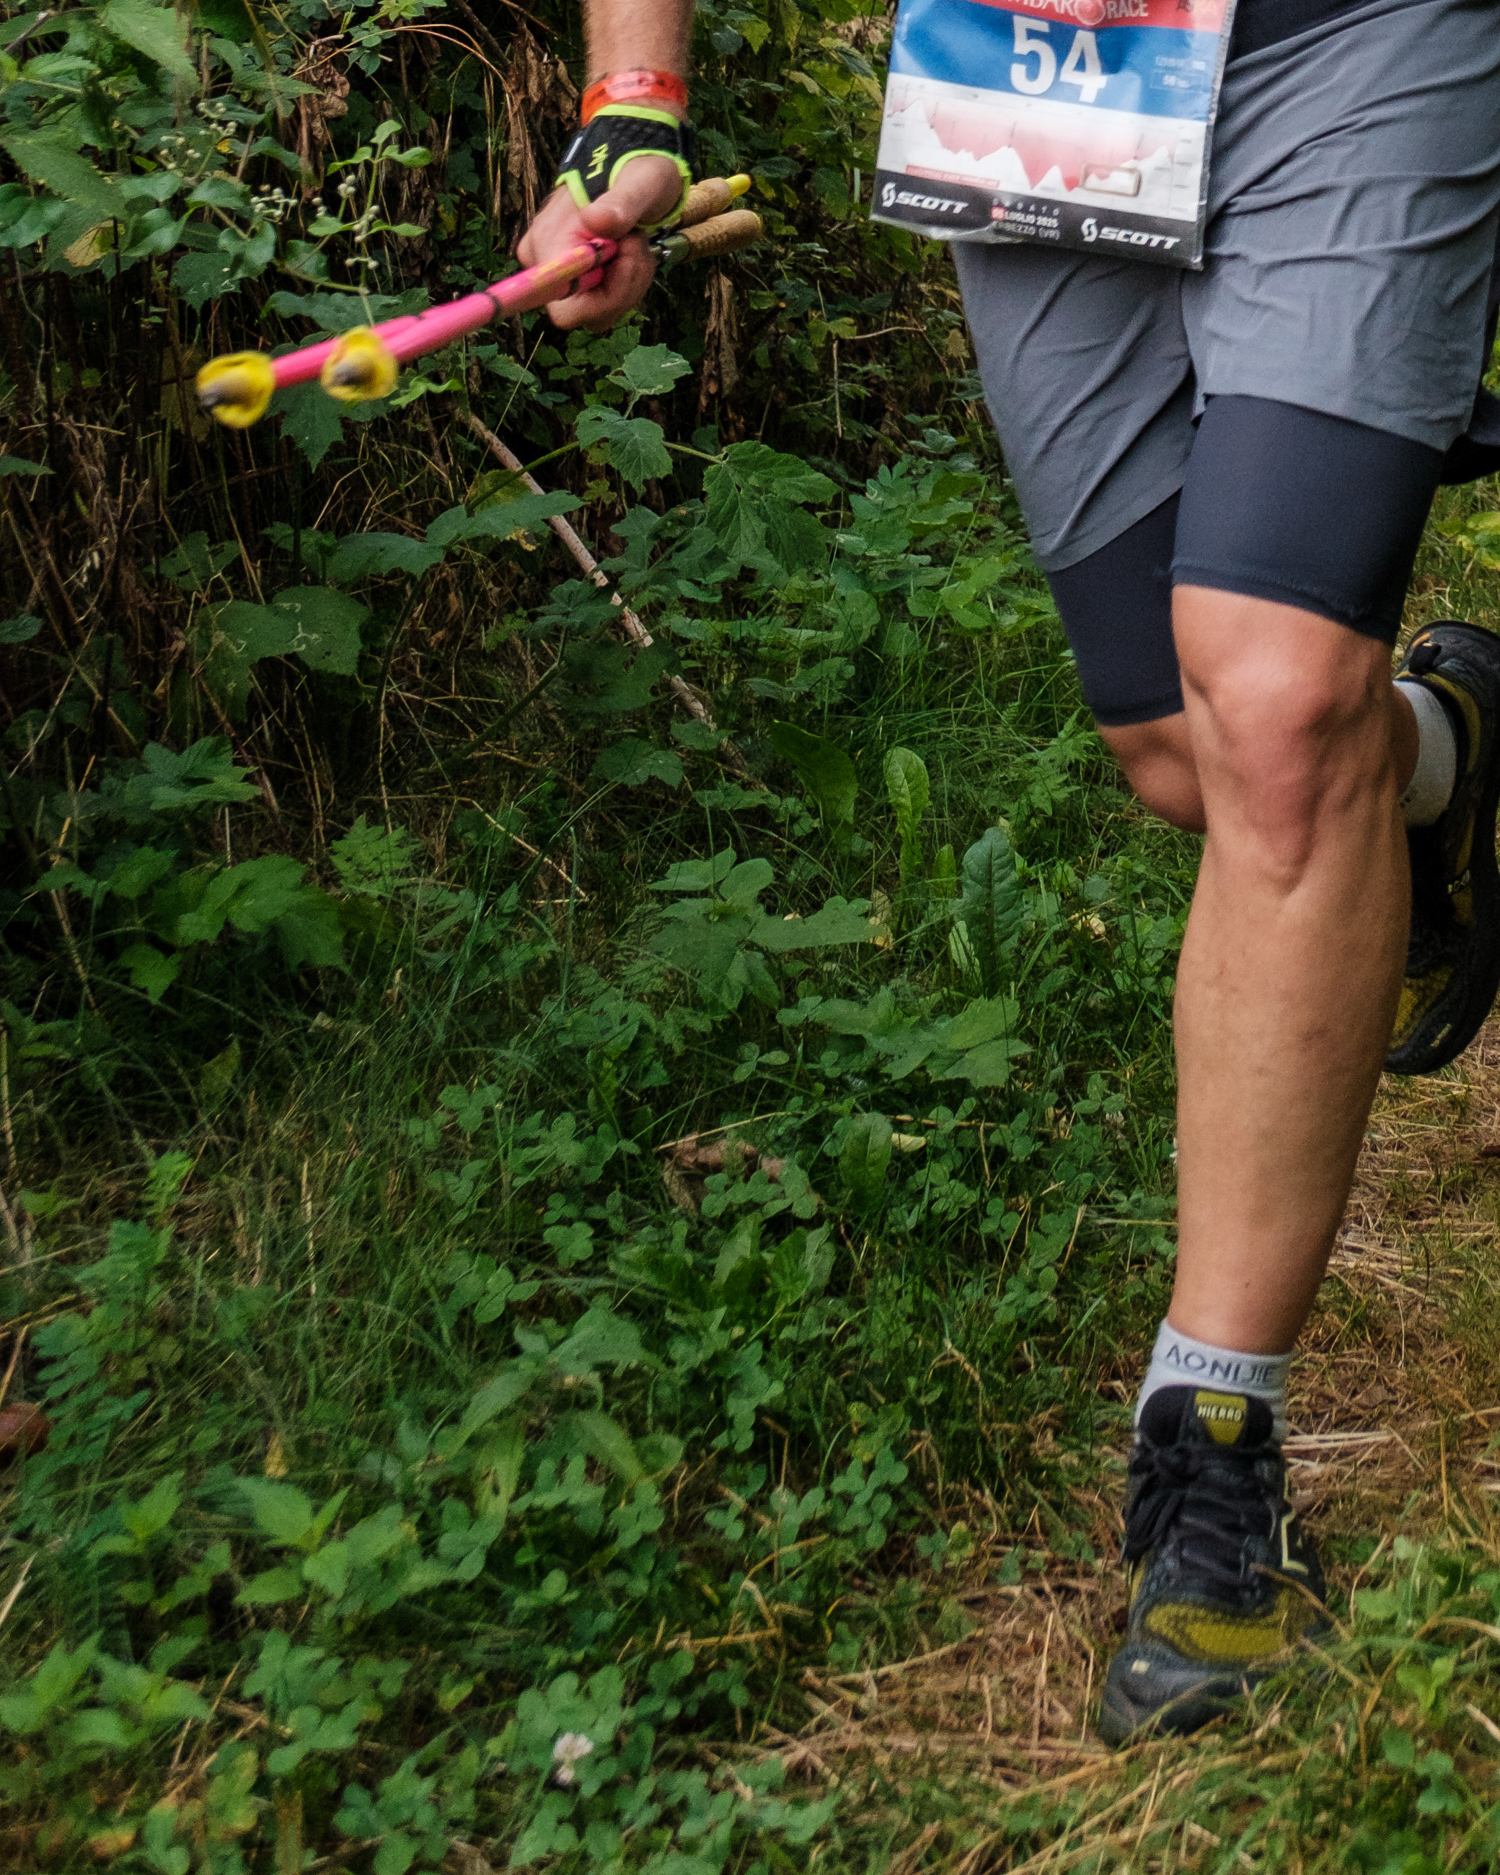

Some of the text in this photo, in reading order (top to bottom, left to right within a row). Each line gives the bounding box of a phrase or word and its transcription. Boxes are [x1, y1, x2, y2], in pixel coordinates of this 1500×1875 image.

[1010, 15, 1107, 104] 54
[895, 191, 969, 214] SCOTT
[1098, 227, 1180, 249] SCOTT
